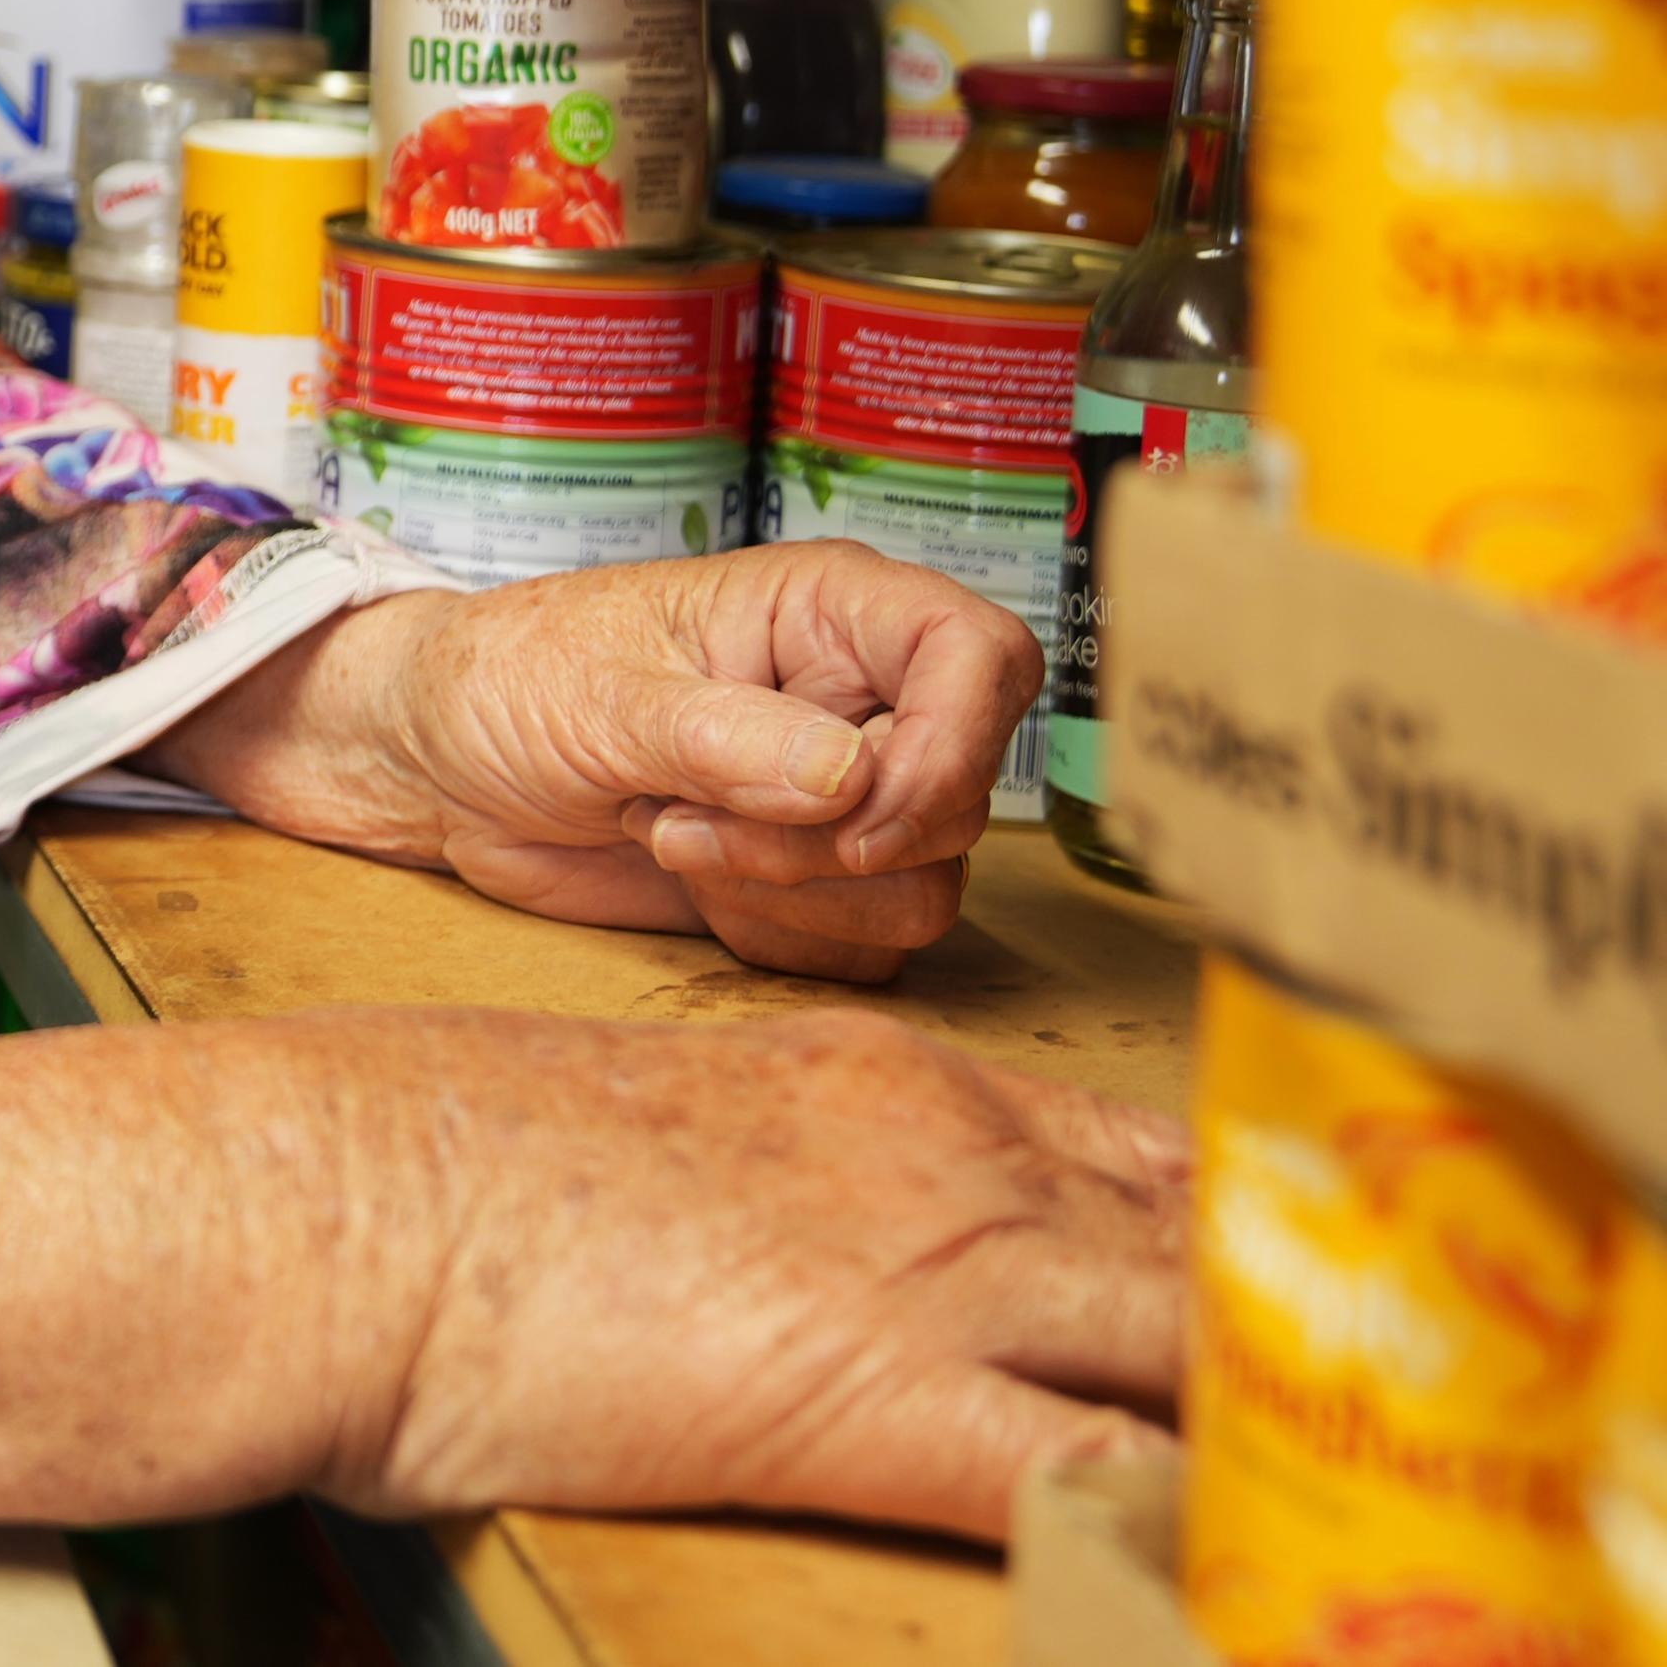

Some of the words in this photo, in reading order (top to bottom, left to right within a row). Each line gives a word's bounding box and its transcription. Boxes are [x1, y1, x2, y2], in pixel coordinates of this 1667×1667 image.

[440, 7, 543, 35] TOMATOES
[409, 36, 579, 85] ORGANIC
[444, 206, 495, 242] 400g
[498, 207, 540, 236] NET
[179, 241, 229, 272] OLD
[437, 464, 522, 482] NUTRITION
[527, 472, 633, 487] INFORMATION
[883, 492, 972, 513] NUTRITION
[977, 503, 1063, 521] INFORMAT
[1057, 625, 1099, 670] ake
